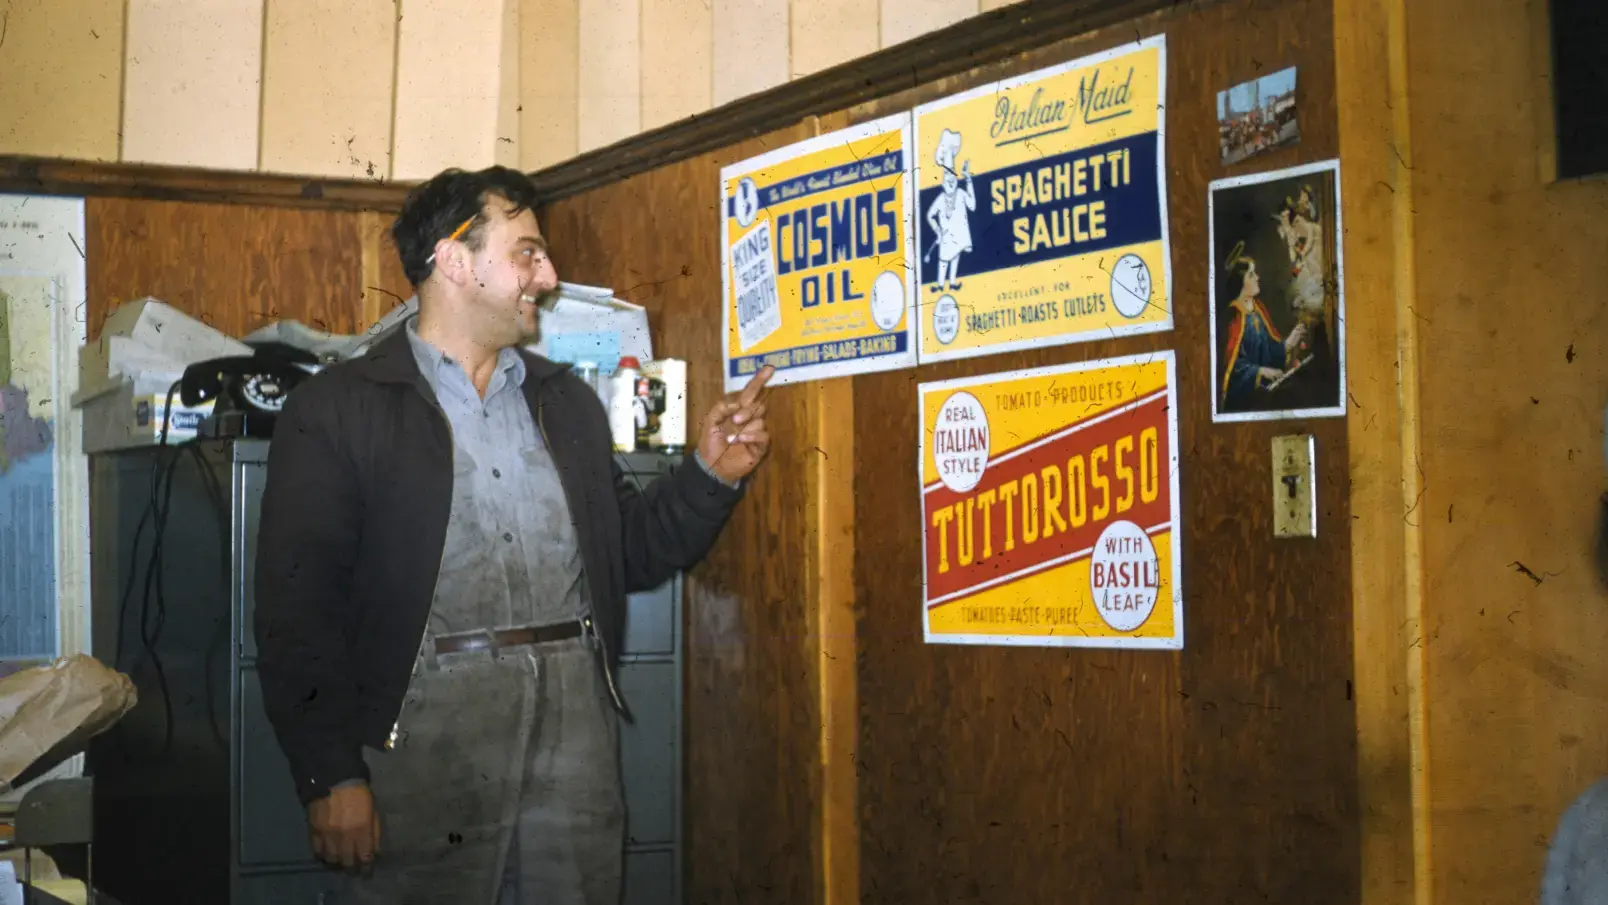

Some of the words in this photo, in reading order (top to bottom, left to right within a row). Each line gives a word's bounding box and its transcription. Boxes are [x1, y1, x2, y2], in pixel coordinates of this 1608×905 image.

[989, 87, 1066, 139] Italian
[1074, 66, 1135, 124] Maid
[990, 148, 1130, 215] SPAGHETTI
[777, 187, 898, 275] COSMOS
[1013, 201, 1107, 254] SAUCE
[734, 226, 769, 270] KING
[801, 269, 864, 308] OIL
[1064, 294, 1106, 318] CUTLETS
[945, 406, 976, 422] REAL
[936, 427, 987, 455] ITALIAN
[943, 457, 981, 474] STYLE
[932, 426, 1158, 574] TUTTOROSSO
[1105, 537, 1143, 555] WITH
[1093, 561, 1156, 588] BASIL
[1104, 593, 1144, 611] LEAF
